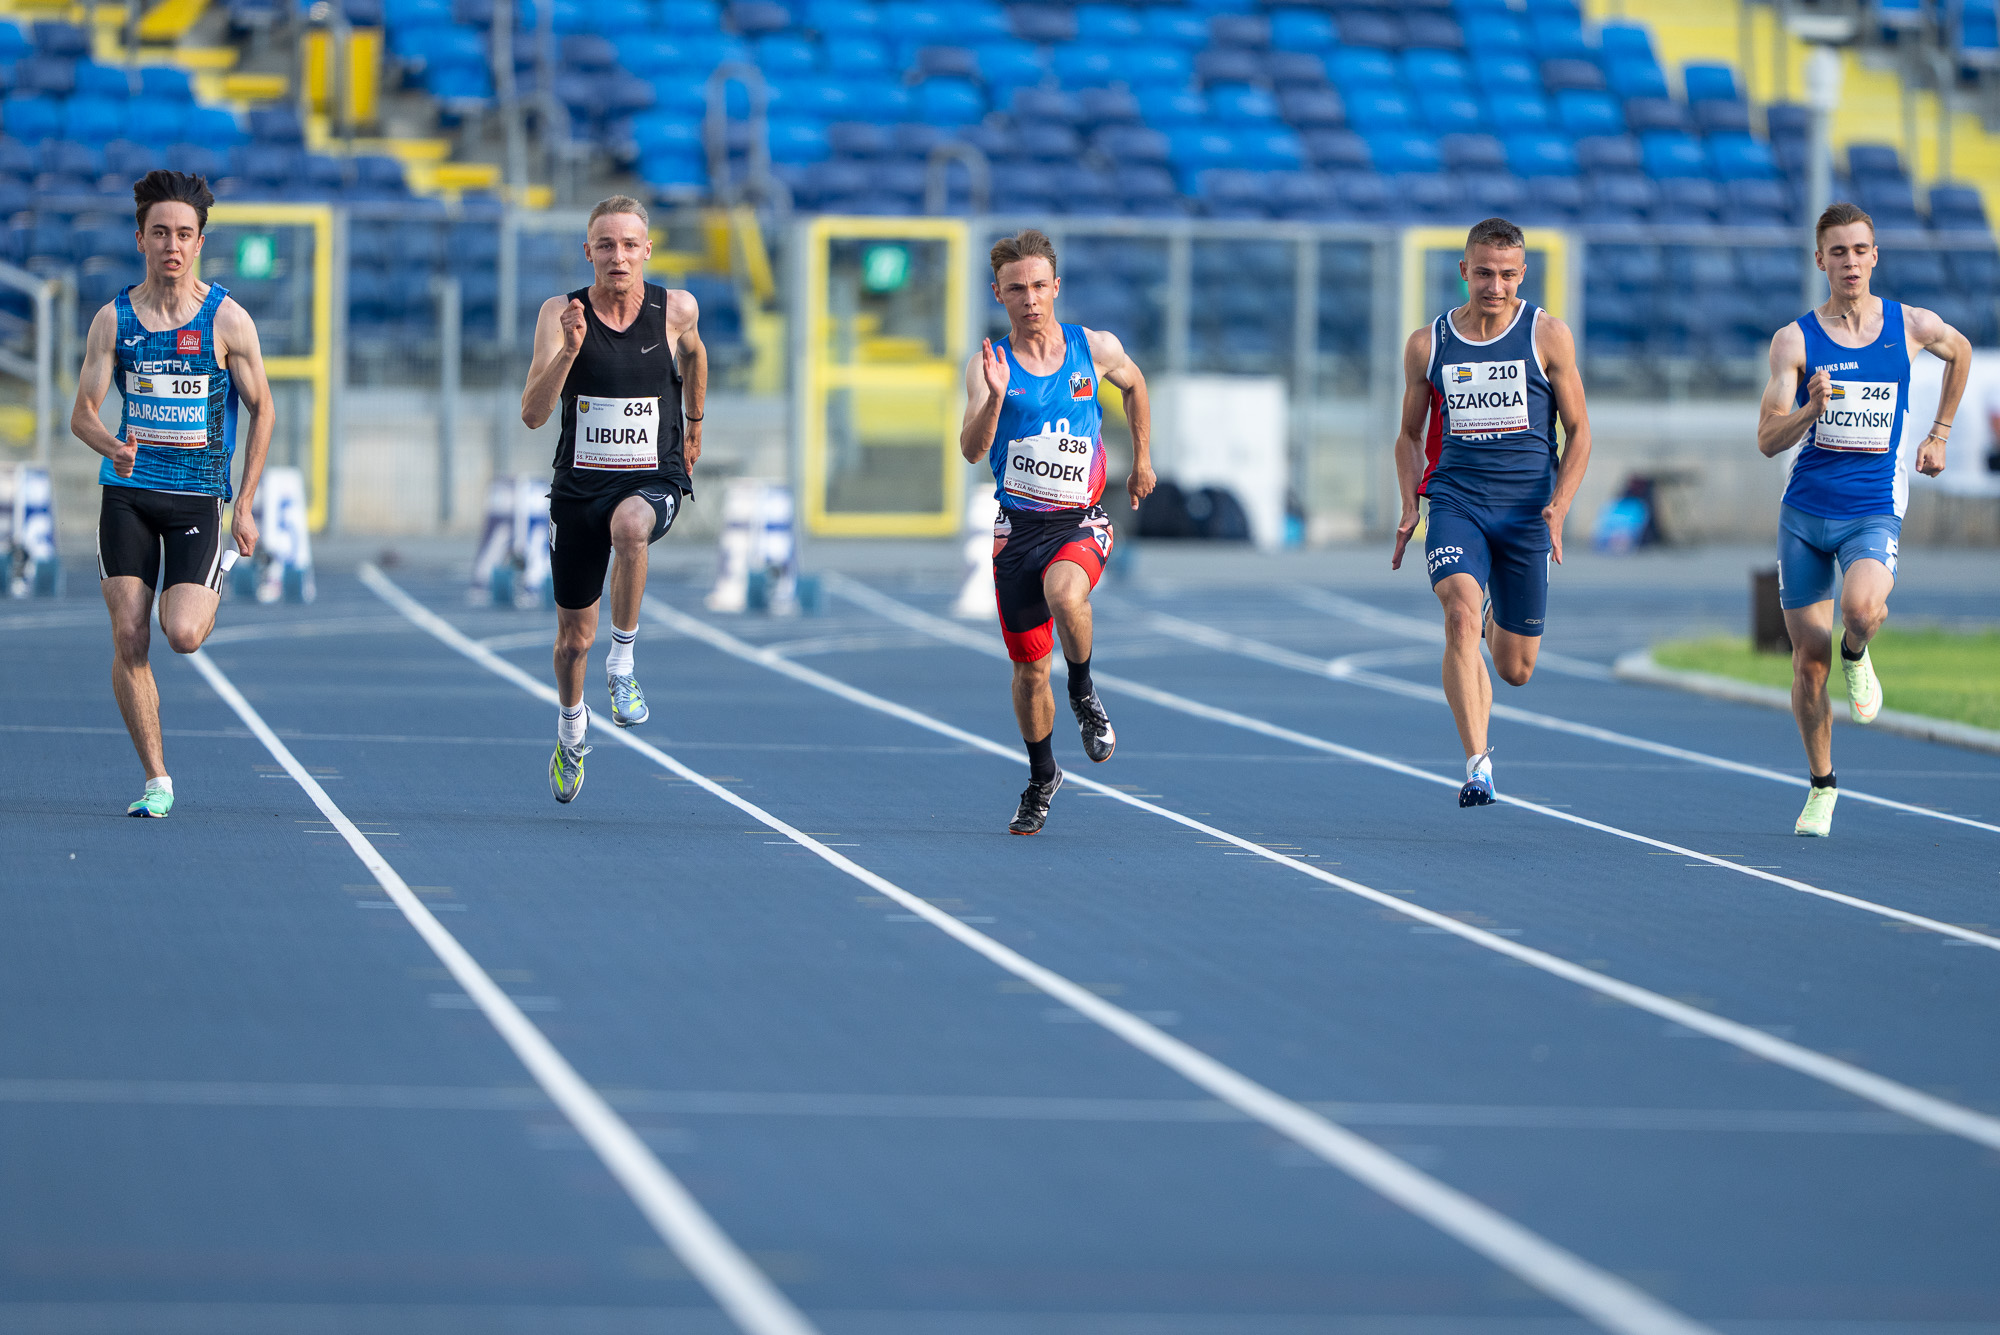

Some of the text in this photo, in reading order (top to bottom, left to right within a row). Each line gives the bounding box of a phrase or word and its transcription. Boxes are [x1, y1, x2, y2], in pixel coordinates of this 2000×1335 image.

[133, 360, 192, 373] VECTRA
[1488, 365, 1518, 380] 210
[1839, 361, 1859, 371] RAWA
[171, 380, 202, 395] 105
[1861, 387, 1890, 400] 246
[1448, 391, 1524, 409] SZAKOŁA
[128, 401, 206, 423] BAJRASZEWSKI
[624, 402, 652, 416] 634
[586, 426, 648, 444] LIBURA
[1058, 438, 1087, 454] 838
[1012, 454, 1085, 482] GRODEK
[1014, 482, 1027, 490] PZLA
[1027, 487, 1058, 498] Mistrzostwa
[1096, 533, 1107, 551] 4
[1427, 546, 1464, 563] GROS
